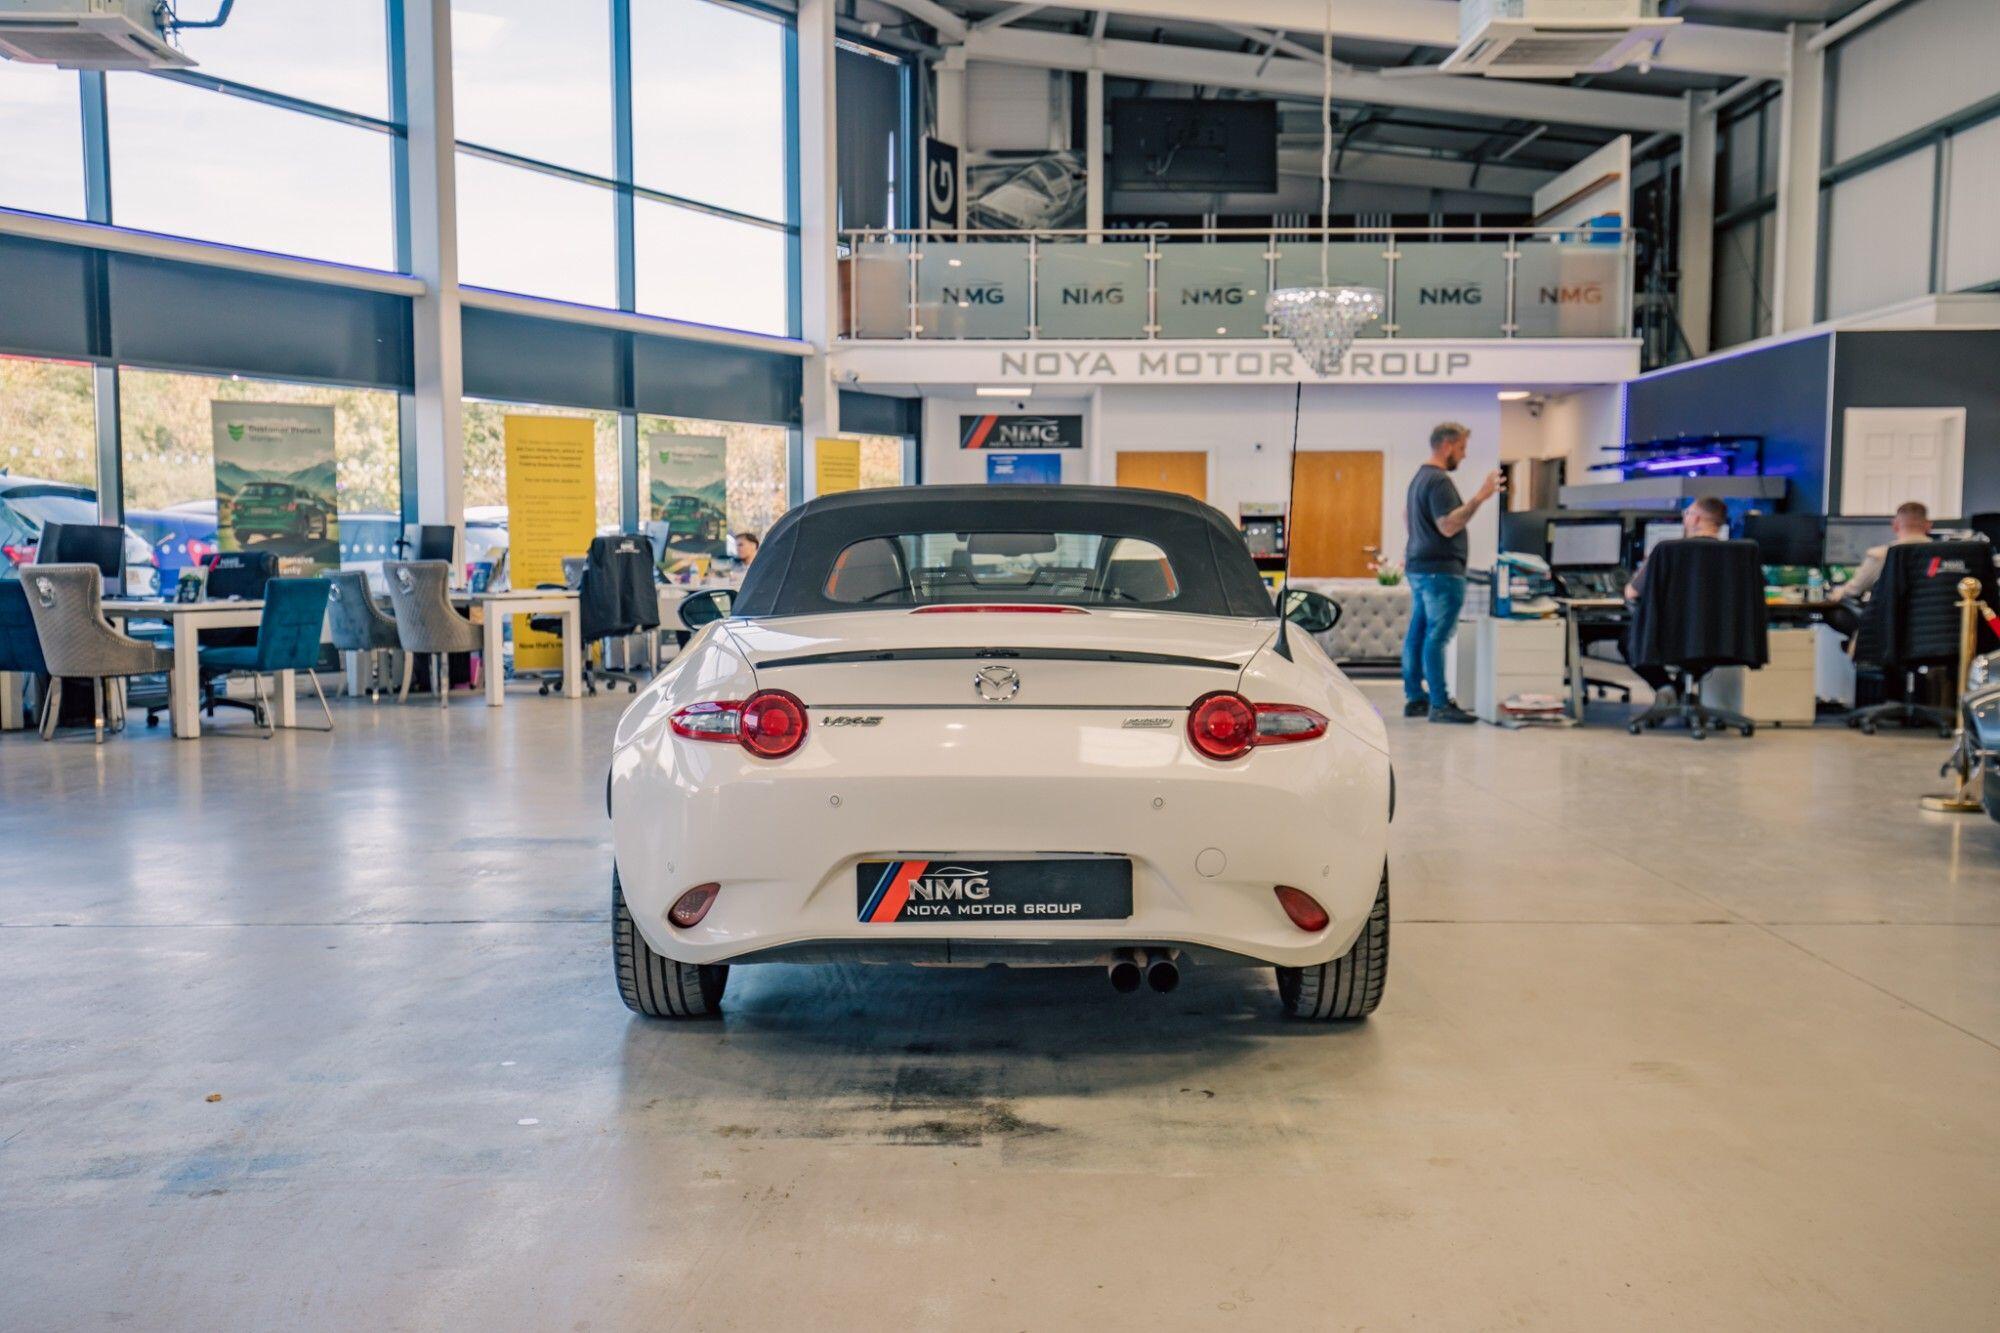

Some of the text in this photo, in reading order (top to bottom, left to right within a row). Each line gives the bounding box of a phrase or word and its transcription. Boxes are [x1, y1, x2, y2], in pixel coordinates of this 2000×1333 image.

[943, 287, 1004, 304] NMG
[1182, 287, 1243, 304] NMG
[1420, 287, 1482, 304] NMG
[1540, 287, 1603, 304] NMG
[1001, 352, 1116, 375] NOYA
[1139, 352, 1294, 375] MOTOR
[999, 424, 1060, 442] NMG
[907, 878, 990, 900] NMG
[907, 903, 1082, 916] NOYA MOTOR GROUP
